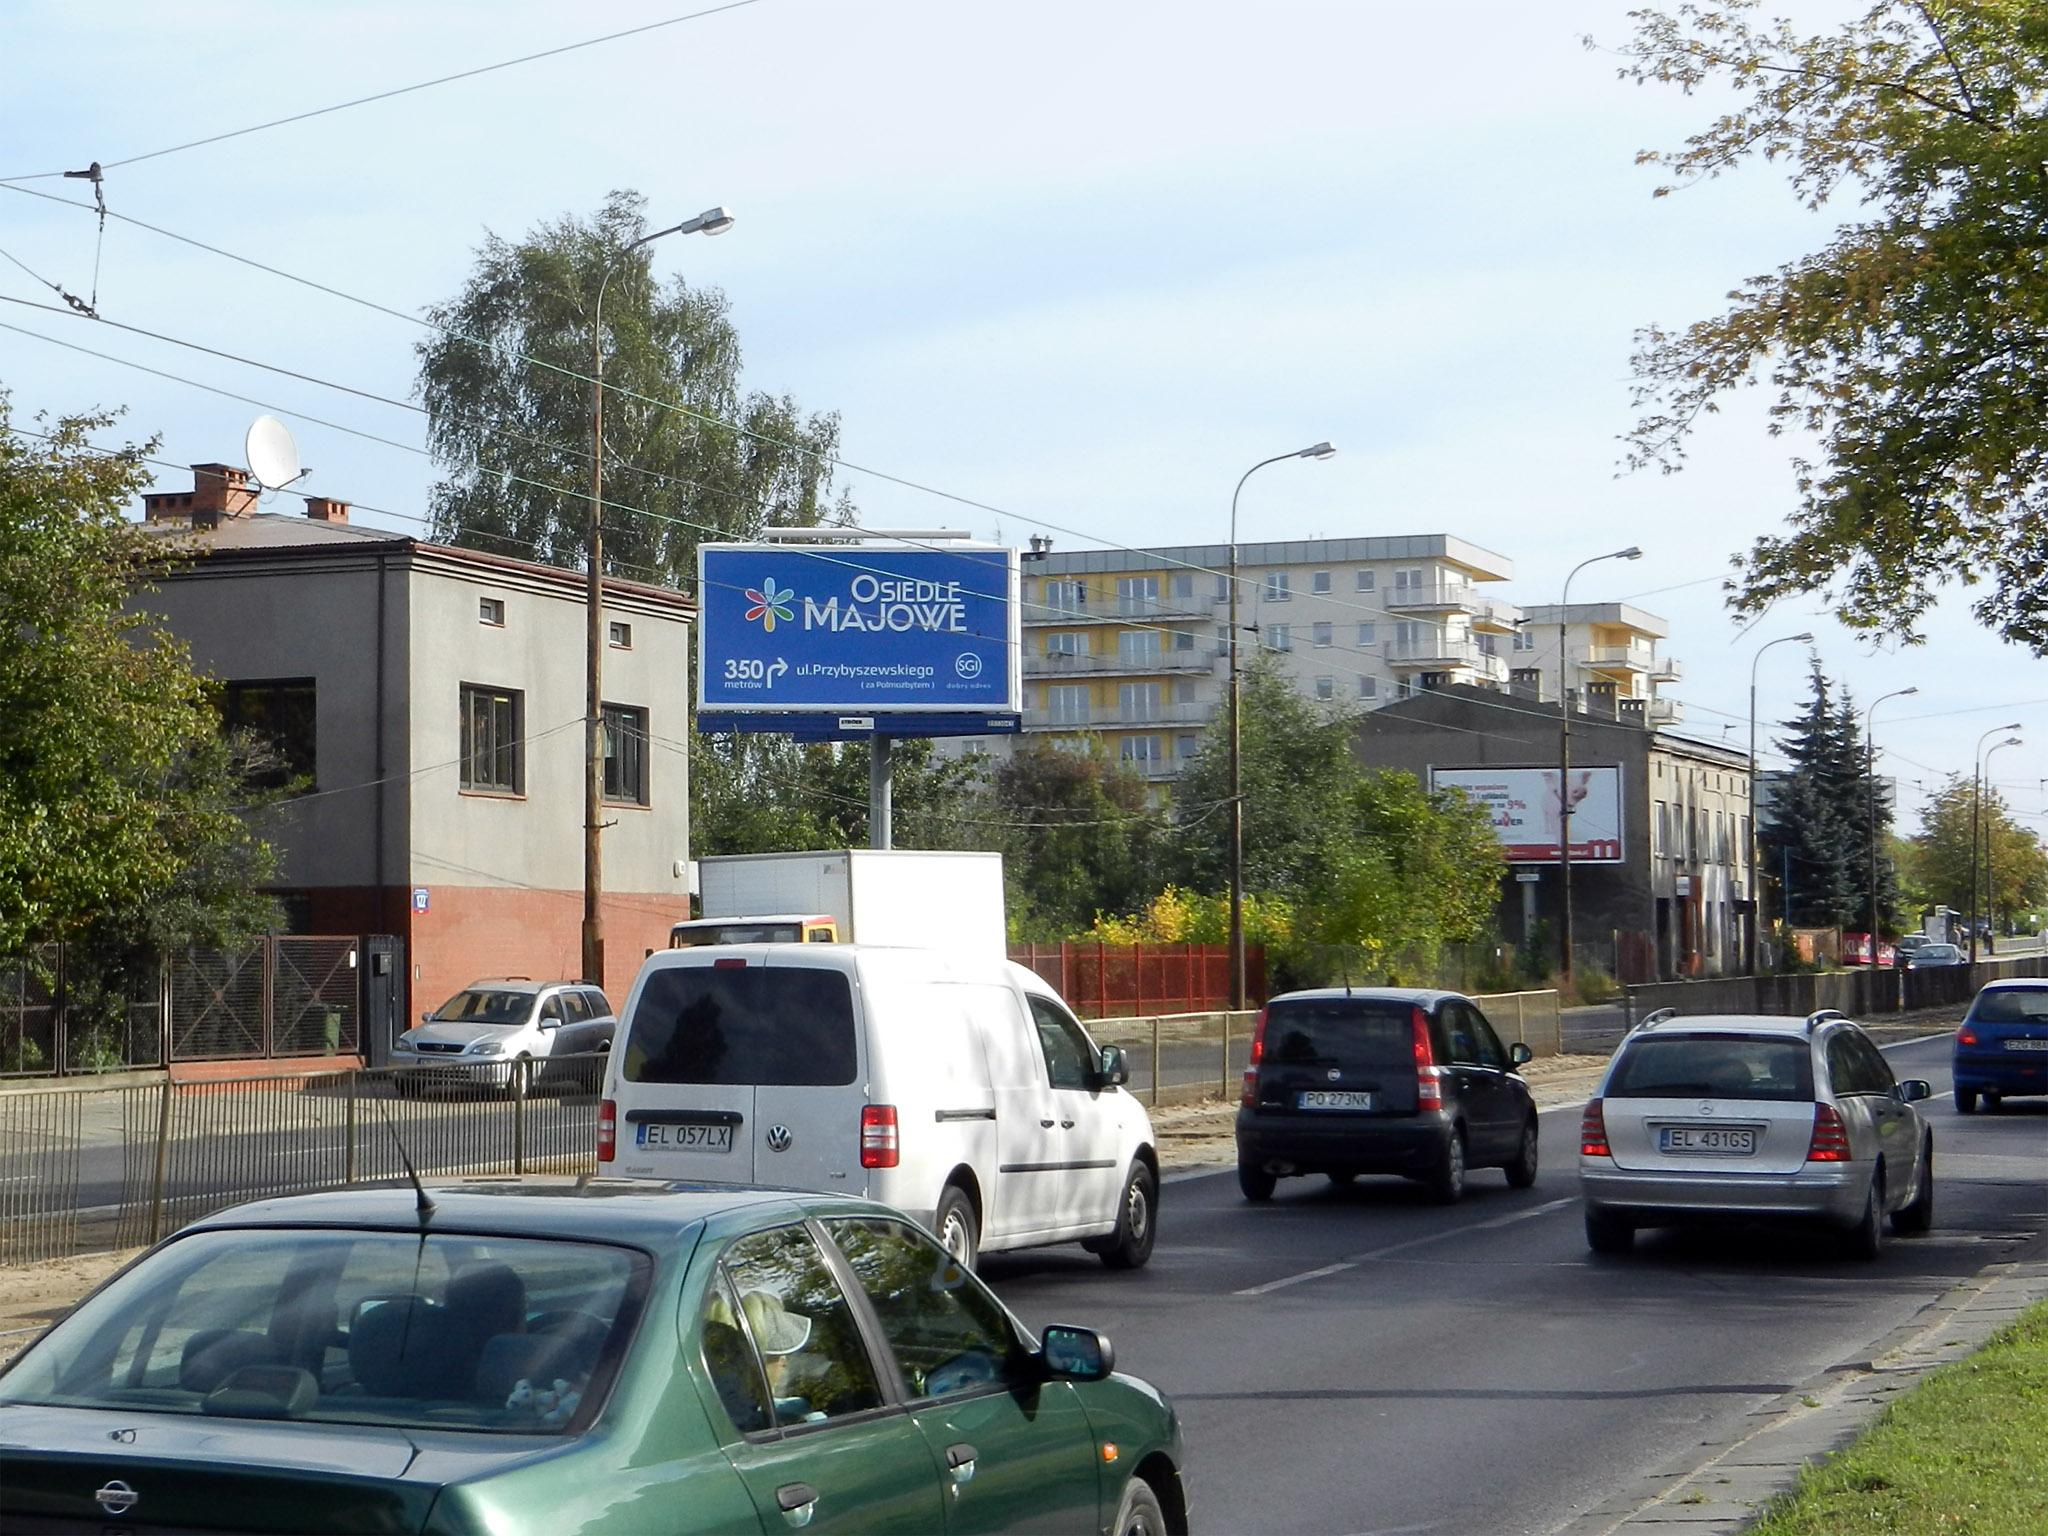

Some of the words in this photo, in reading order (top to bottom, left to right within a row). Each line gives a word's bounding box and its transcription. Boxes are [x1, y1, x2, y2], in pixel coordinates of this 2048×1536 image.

[851, 574, 961, 603] OSIEDLE
[804, 596, 967, 633] MAJOWE
[724, 659, 764, 680] 350
[796, 663, 934, 679] ul.Przybyszewskiego
[958, 659, 979, 672] SGI
[724, 680, 763, 689] metrów
[1307, 1093, 1325, 1106] PO
[1328, 1093, 1369, 1107] 273NK
[647, 1126, 669, 1144] EL
[676, 1127, 728, 1146] 057LX
[1671, 1130, 1694, 1147] EL
[1700, 1131, 1751, 1148] 431GS
